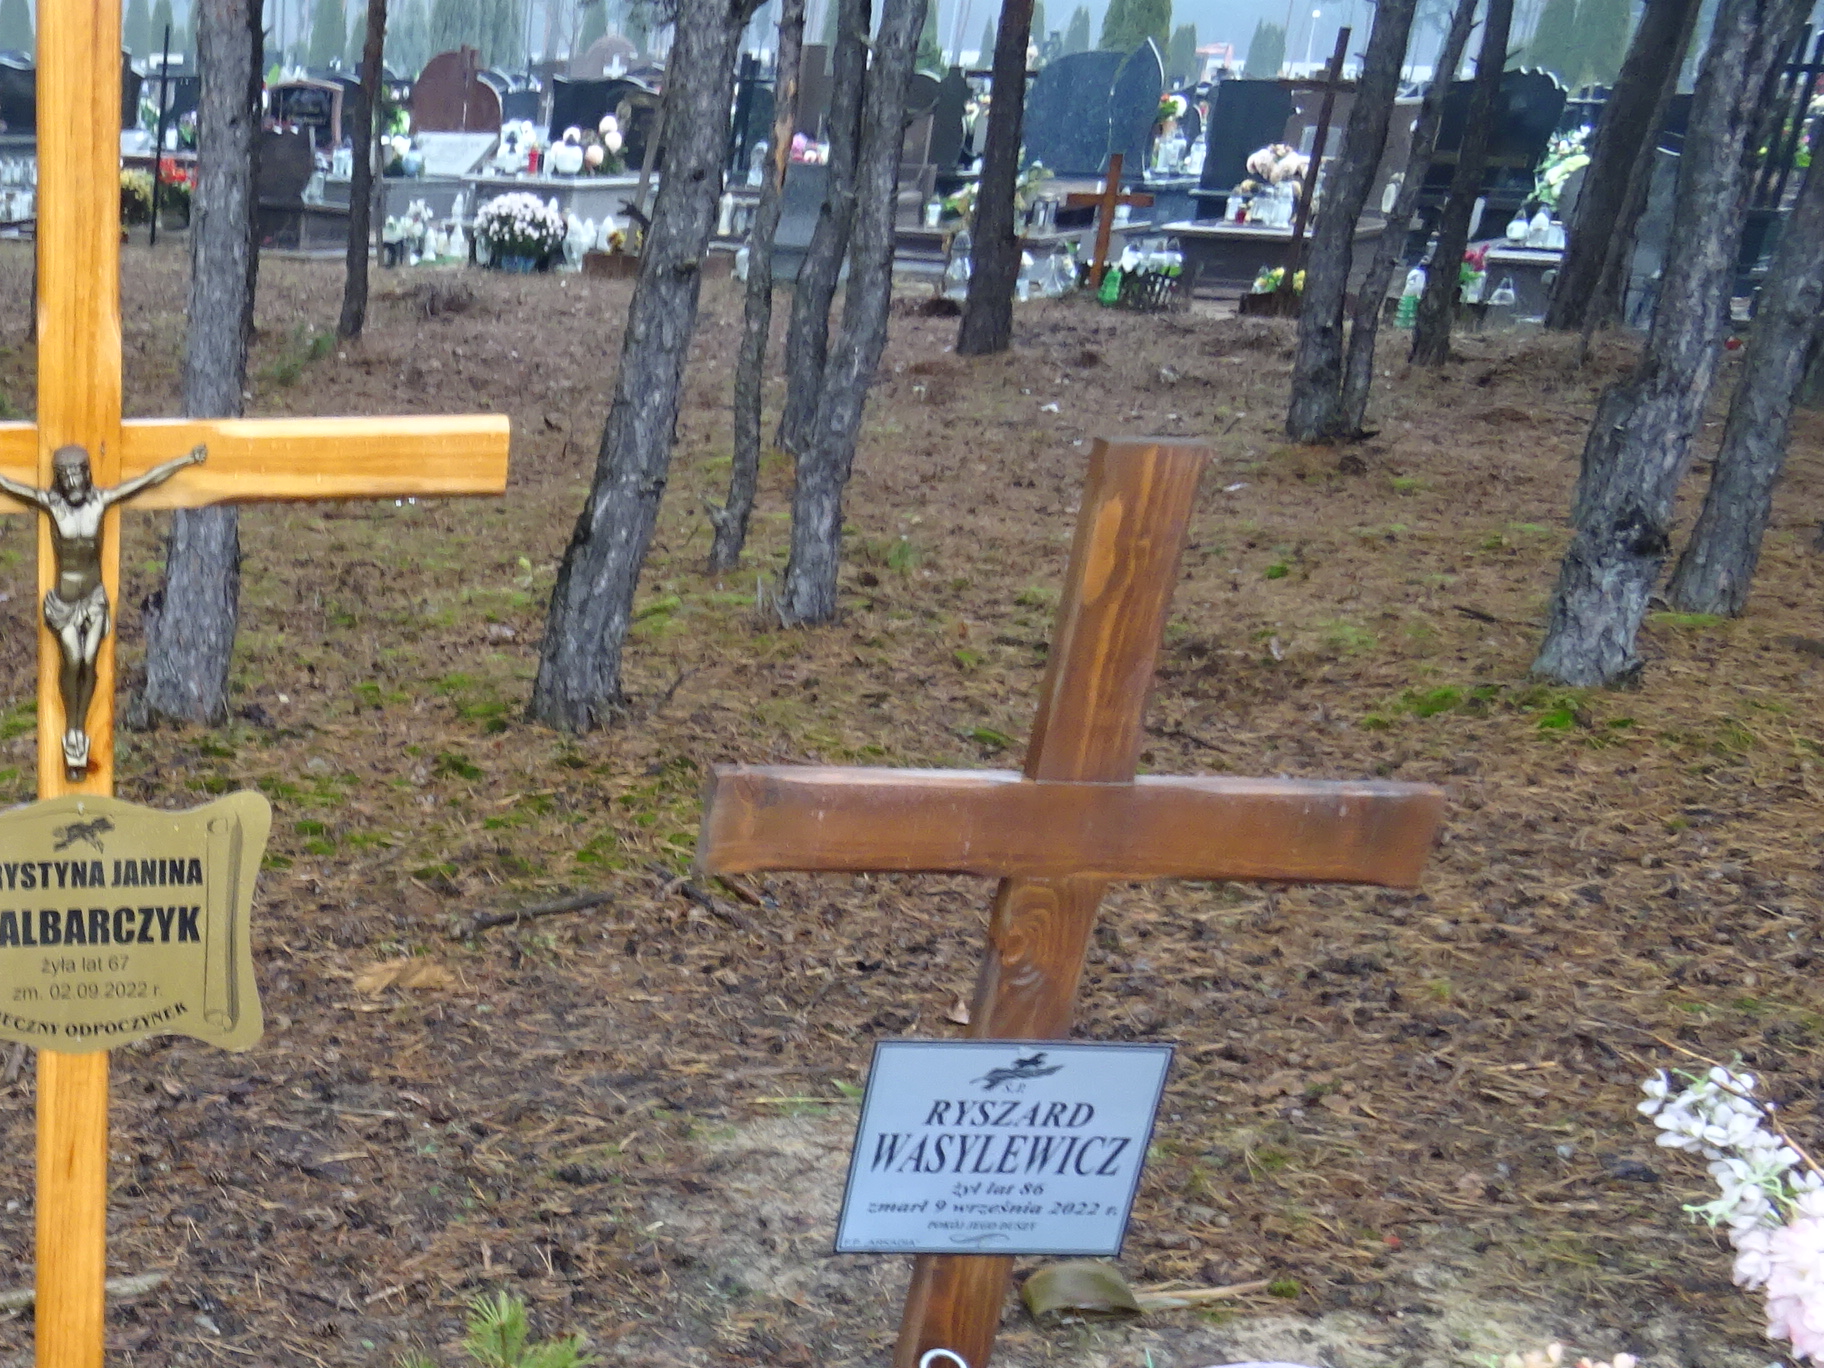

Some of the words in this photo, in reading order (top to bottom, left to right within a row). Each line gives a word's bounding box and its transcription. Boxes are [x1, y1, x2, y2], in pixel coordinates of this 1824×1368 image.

[110, 857, 203, 888] JANINA
[82, 956, 104, 974] lat
[108, 953, 130, 971] 67
[65, 1001, 189, 1038] ODPOCZYNEK
[925, 1099, 1096, 1128] RYSZARD
[870, 1132, 1132, 1176] WASYLEWICZ
[1048, 1201, 1100, 1216] 2022
